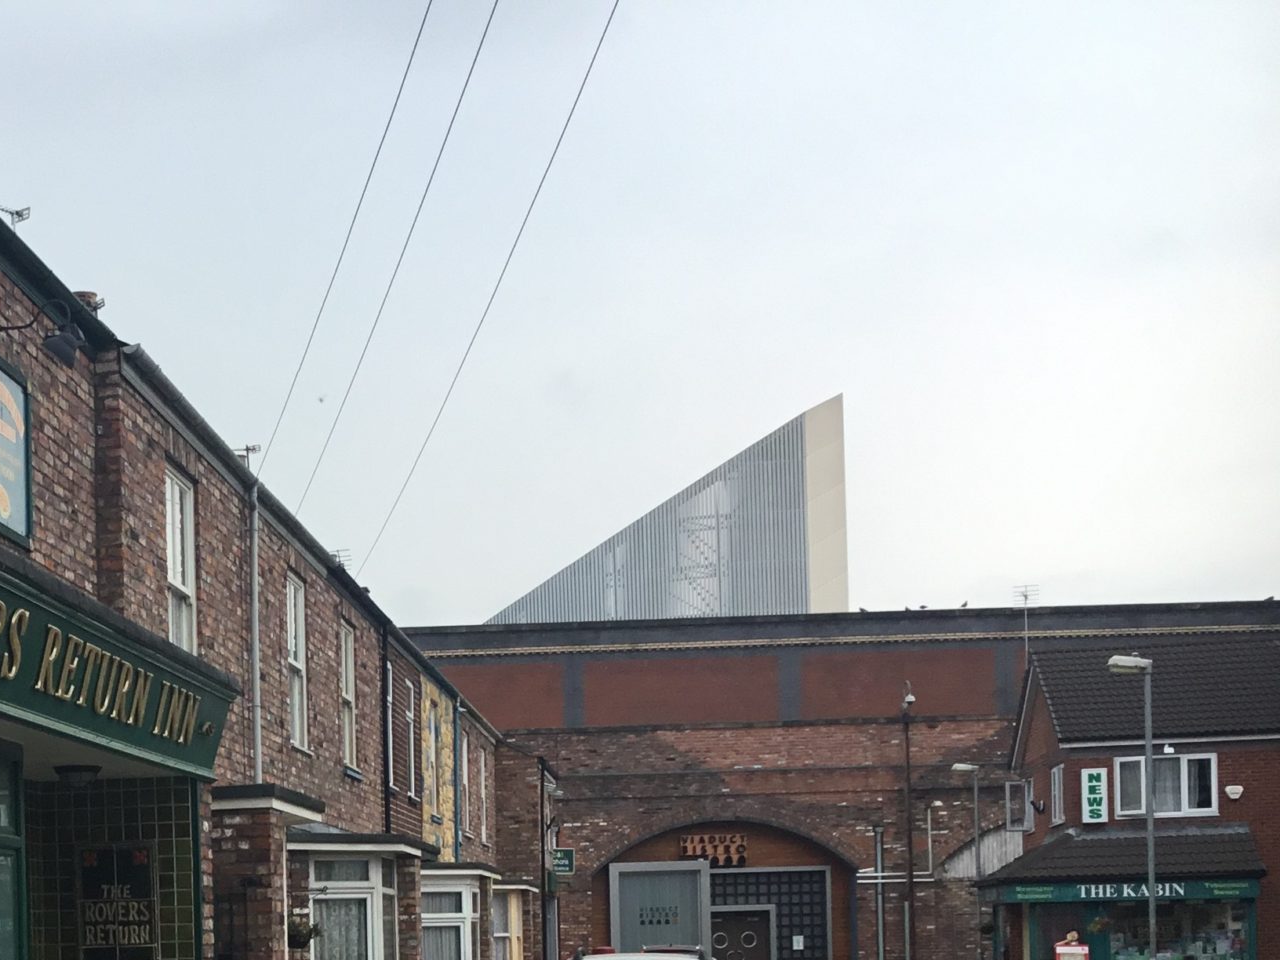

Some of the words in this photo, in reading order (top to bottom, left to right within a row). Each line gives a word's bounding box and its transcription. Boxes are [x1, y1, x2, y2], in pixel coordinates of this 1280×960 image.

[35, 623, 154, 728] RETURN
[152, 680, 202, 745] INN
[1087, 773, 1104, 820] NEWS
[681, 834, 745, 845] VIADUCT
[682, 844, 746, 855] BISTRO
[101, 885, 131, 899] THE
[1076, 884, 1118, 898] THE
[1122, 882, 1185, 898] KABIN
[85, 901, 150, 922] ROVERS
[85, 925, 150, 945] RETURN
